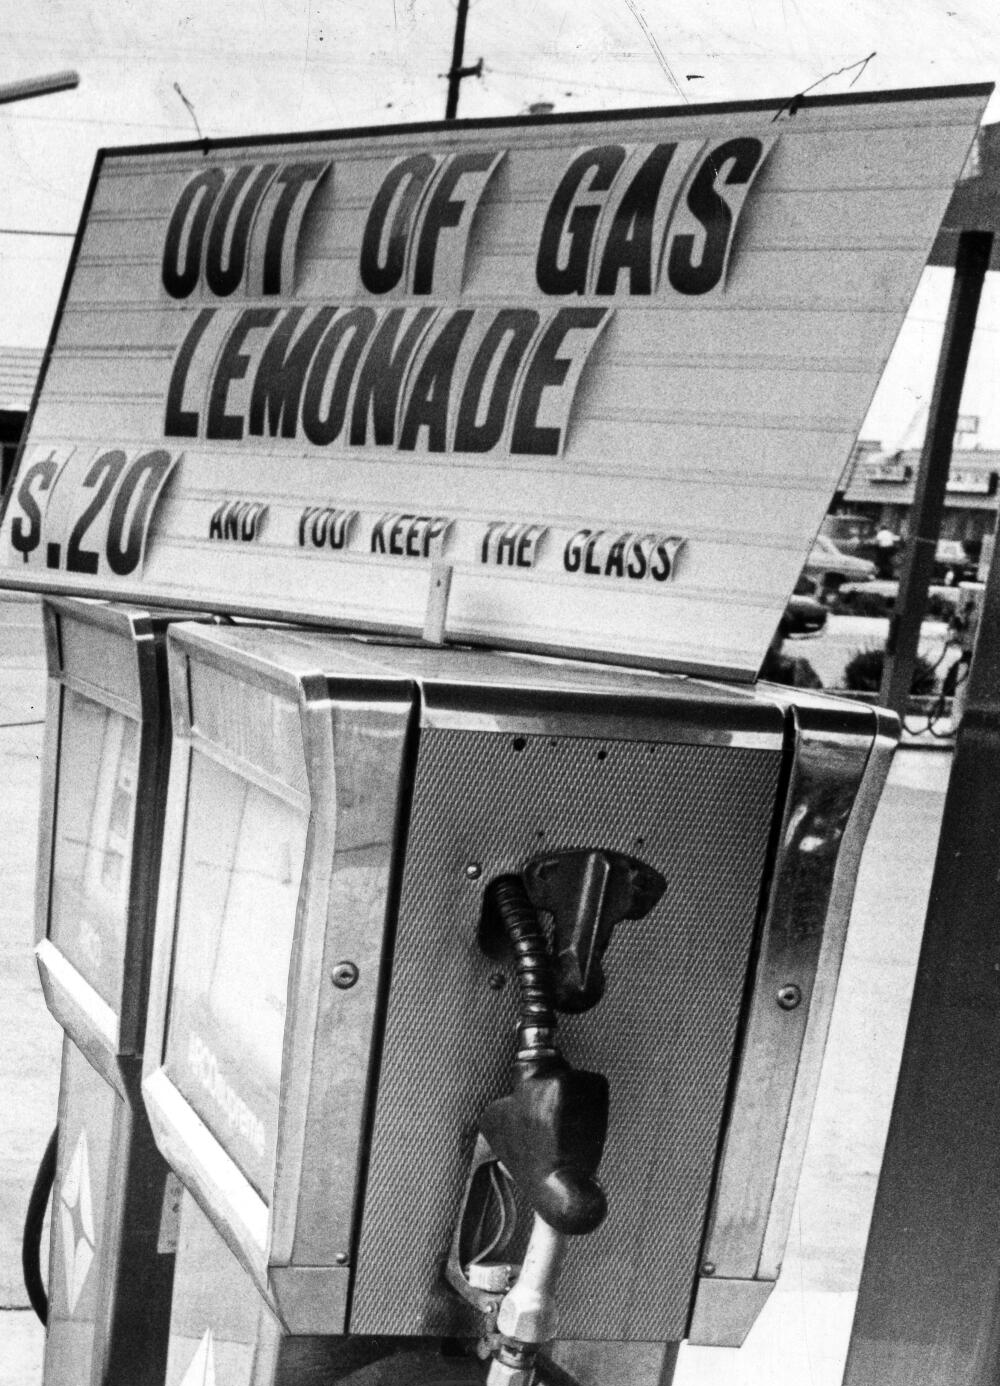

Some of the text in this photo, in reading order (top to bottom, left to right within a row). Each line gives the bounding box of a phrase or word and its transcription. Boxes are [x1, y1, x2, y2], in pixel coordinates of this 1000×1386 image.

[162, 137, 763, 299] OUT OF GAS
[164, 307, 609, 456] LEMONADE
[11, 450, 682, 582] $.20 AND YOU KEEP THE GLASS
